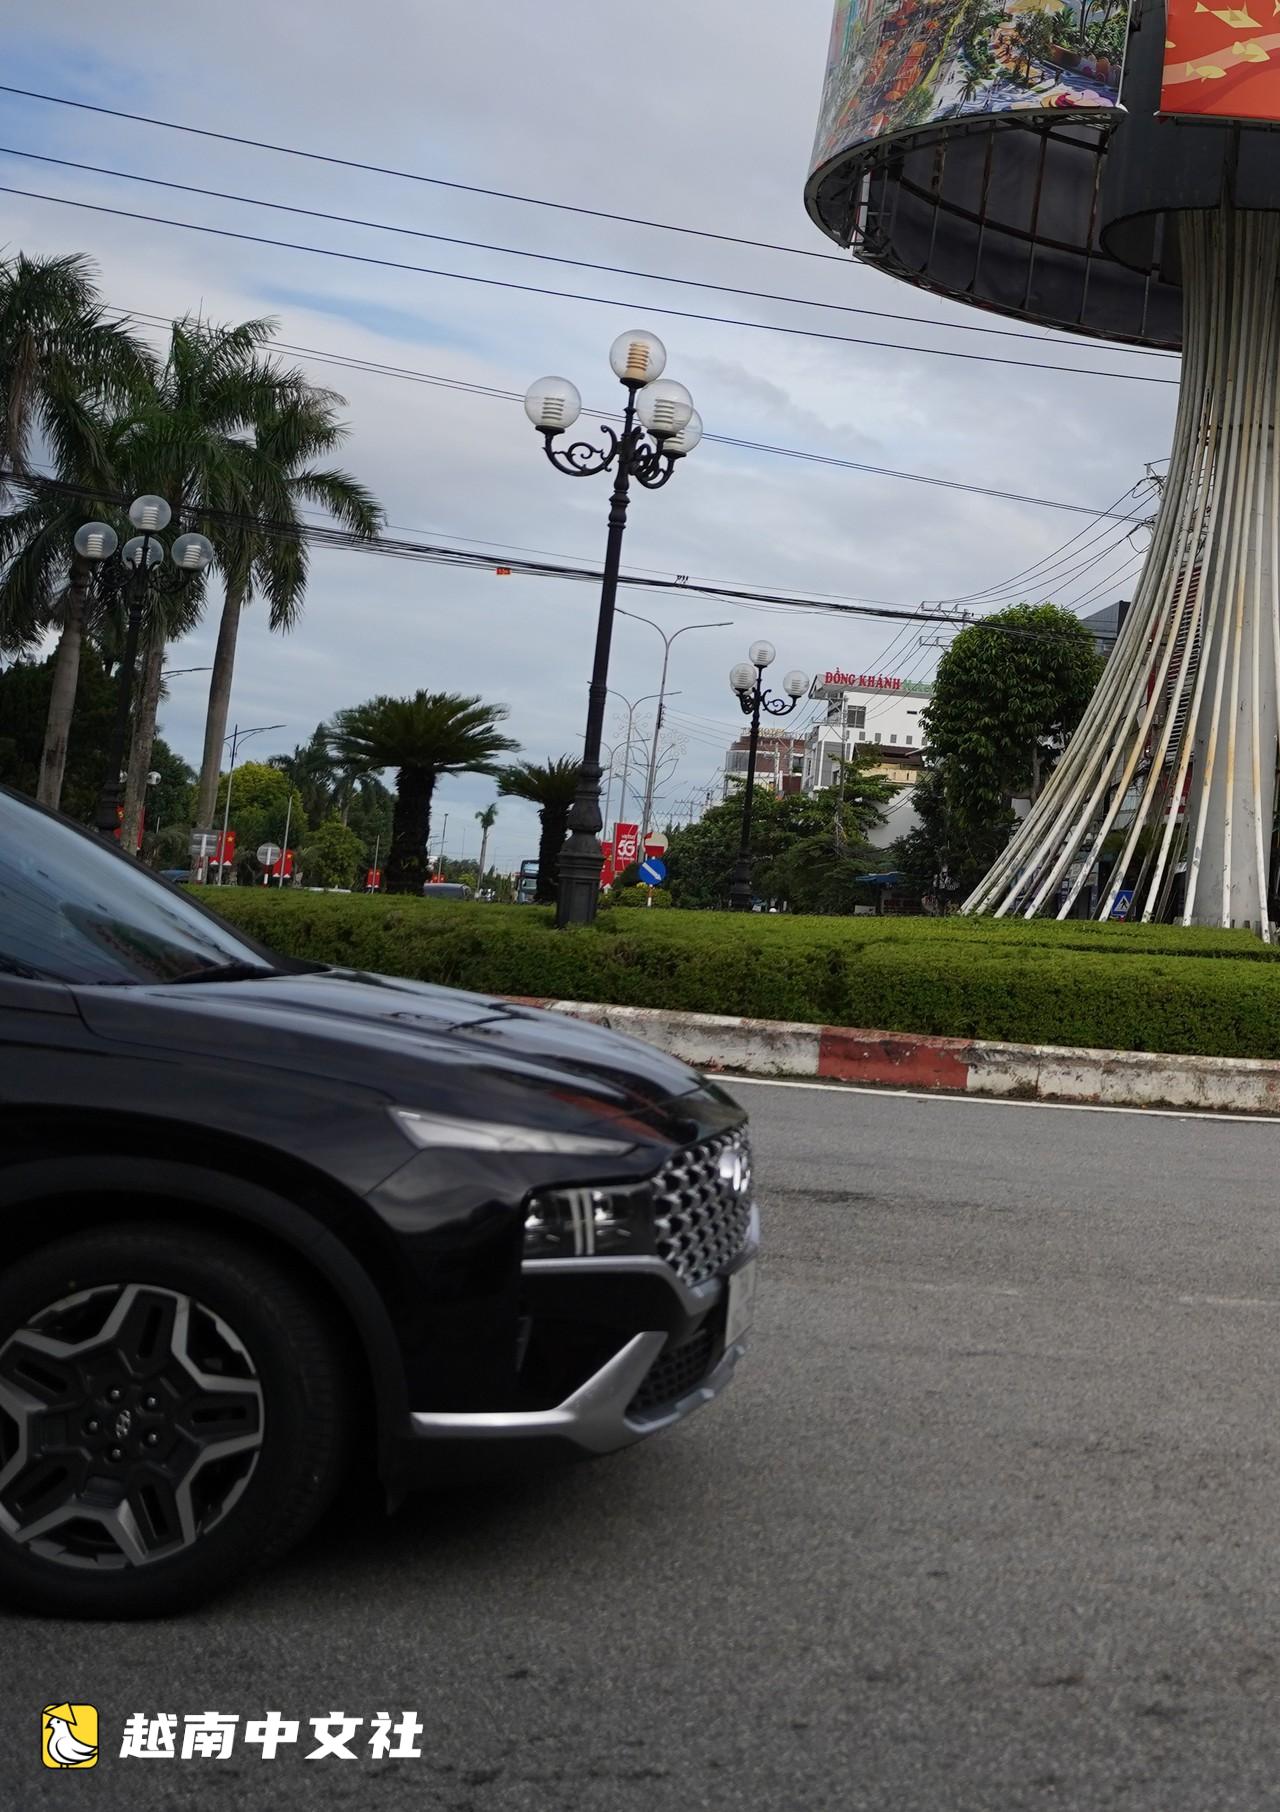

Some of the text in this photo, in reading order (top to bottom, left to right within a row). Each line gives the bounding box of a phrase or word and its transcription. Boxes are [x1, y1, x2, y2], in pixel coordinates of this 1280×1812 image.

[825, 667, 856, 685] ĐỒNG
[859, 673, 902, 690] KHÁNH
[617, 839, 636, 857] 5G
